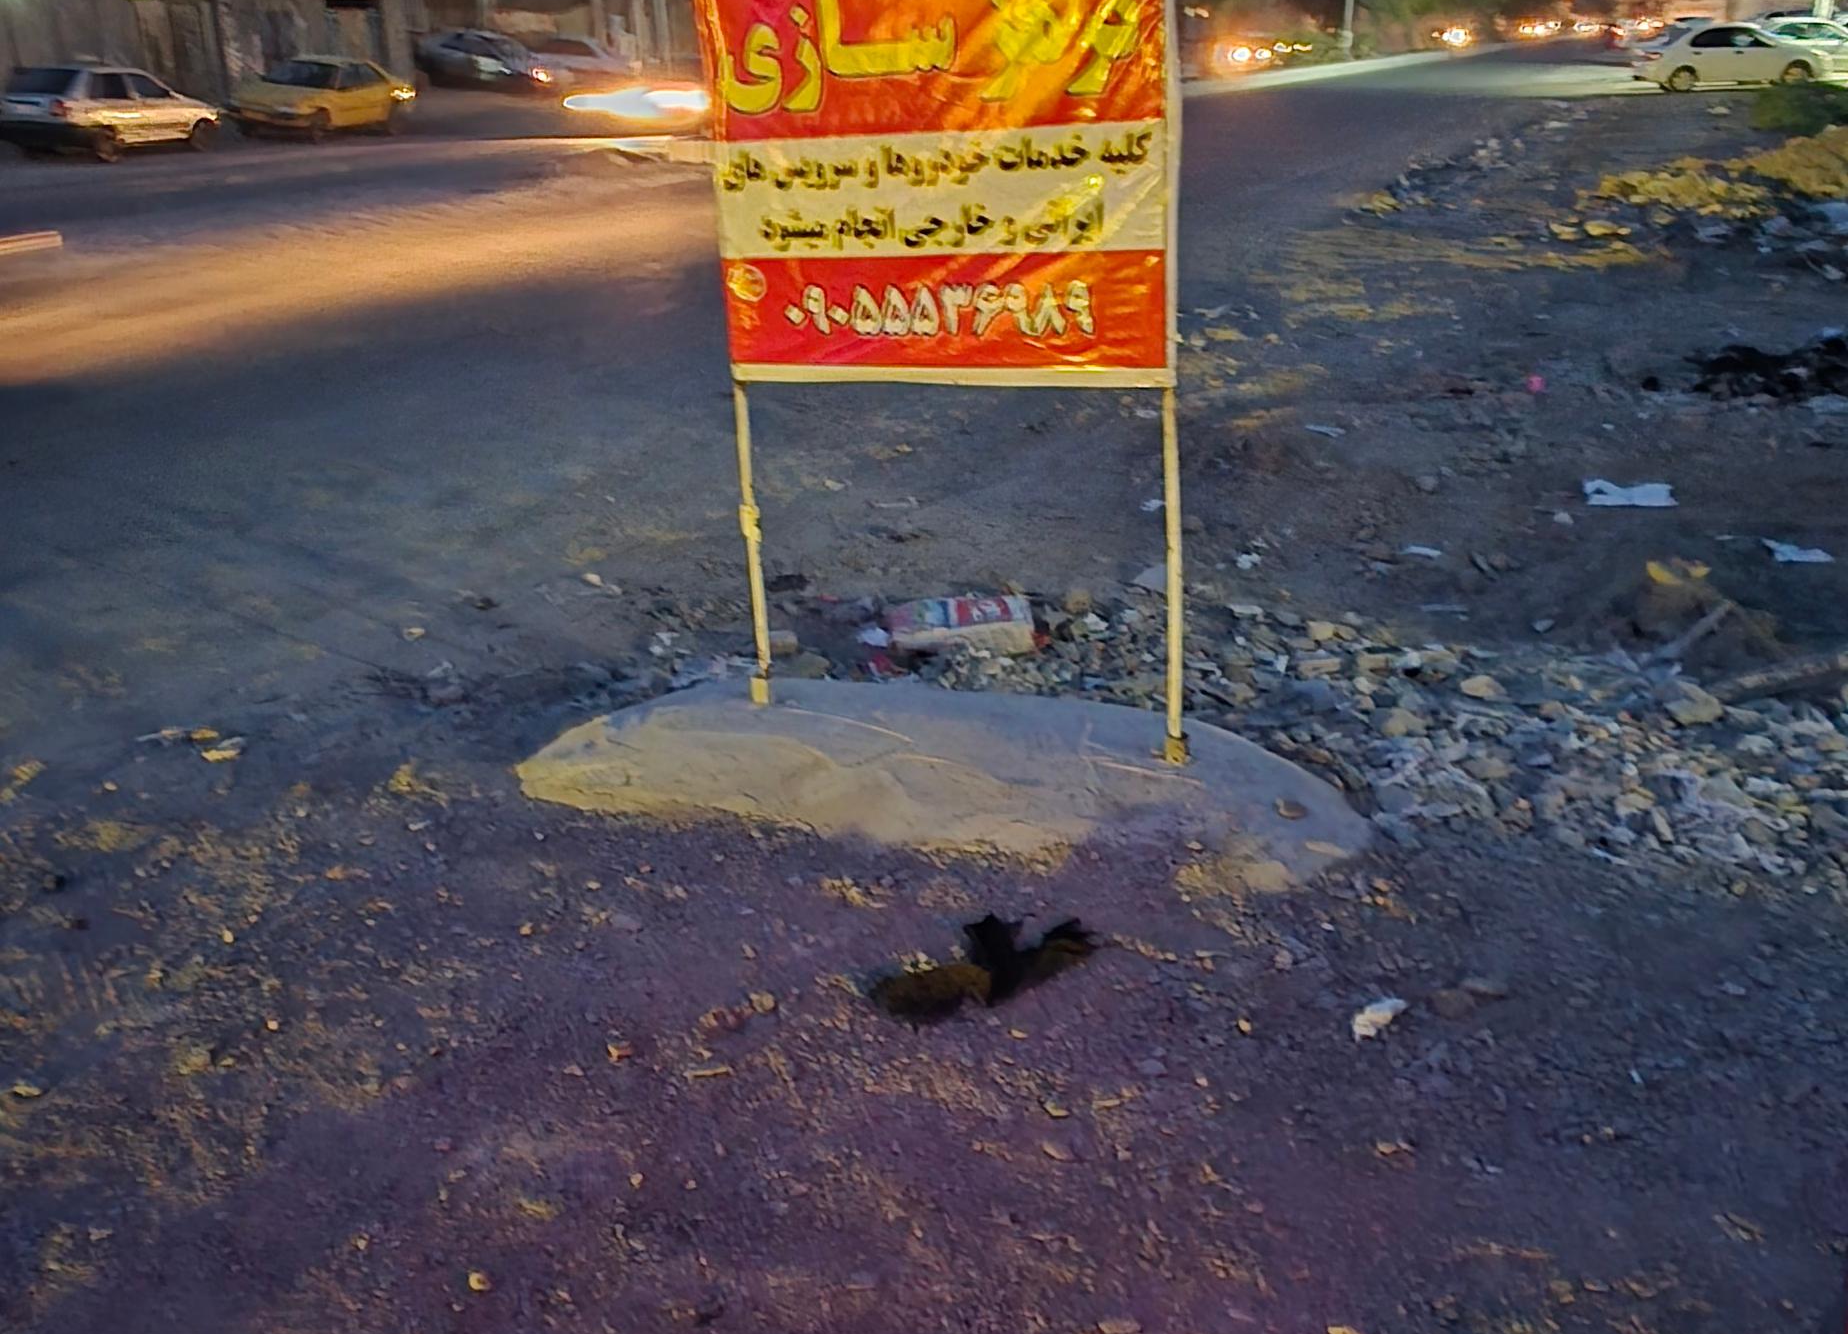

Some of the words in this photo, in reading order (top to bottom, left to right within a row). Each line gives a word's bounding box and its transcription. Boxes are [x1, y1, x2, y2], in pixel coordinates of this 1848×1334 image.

[722, 148, 768, 192] های
[772, 156, 859, 191] سرویس
[863, 158, 880, 189] و
[880, 140, 989, 187] خودروها
[992, 131, 1090, 171] خدمات
[1099, 130, 1153, 175] کلیه
[758, 208, 830, 253] میشود
[830, 205, 897, 251] انجام
[899, 203, 995, 248] خارجی
[999, 216, 1018, 246] و
[1023, 197, 1104, 247] ایرانی
[784, 279, 1096, 339] ۰۹۰۵۵۵۳۶۹۸۹
